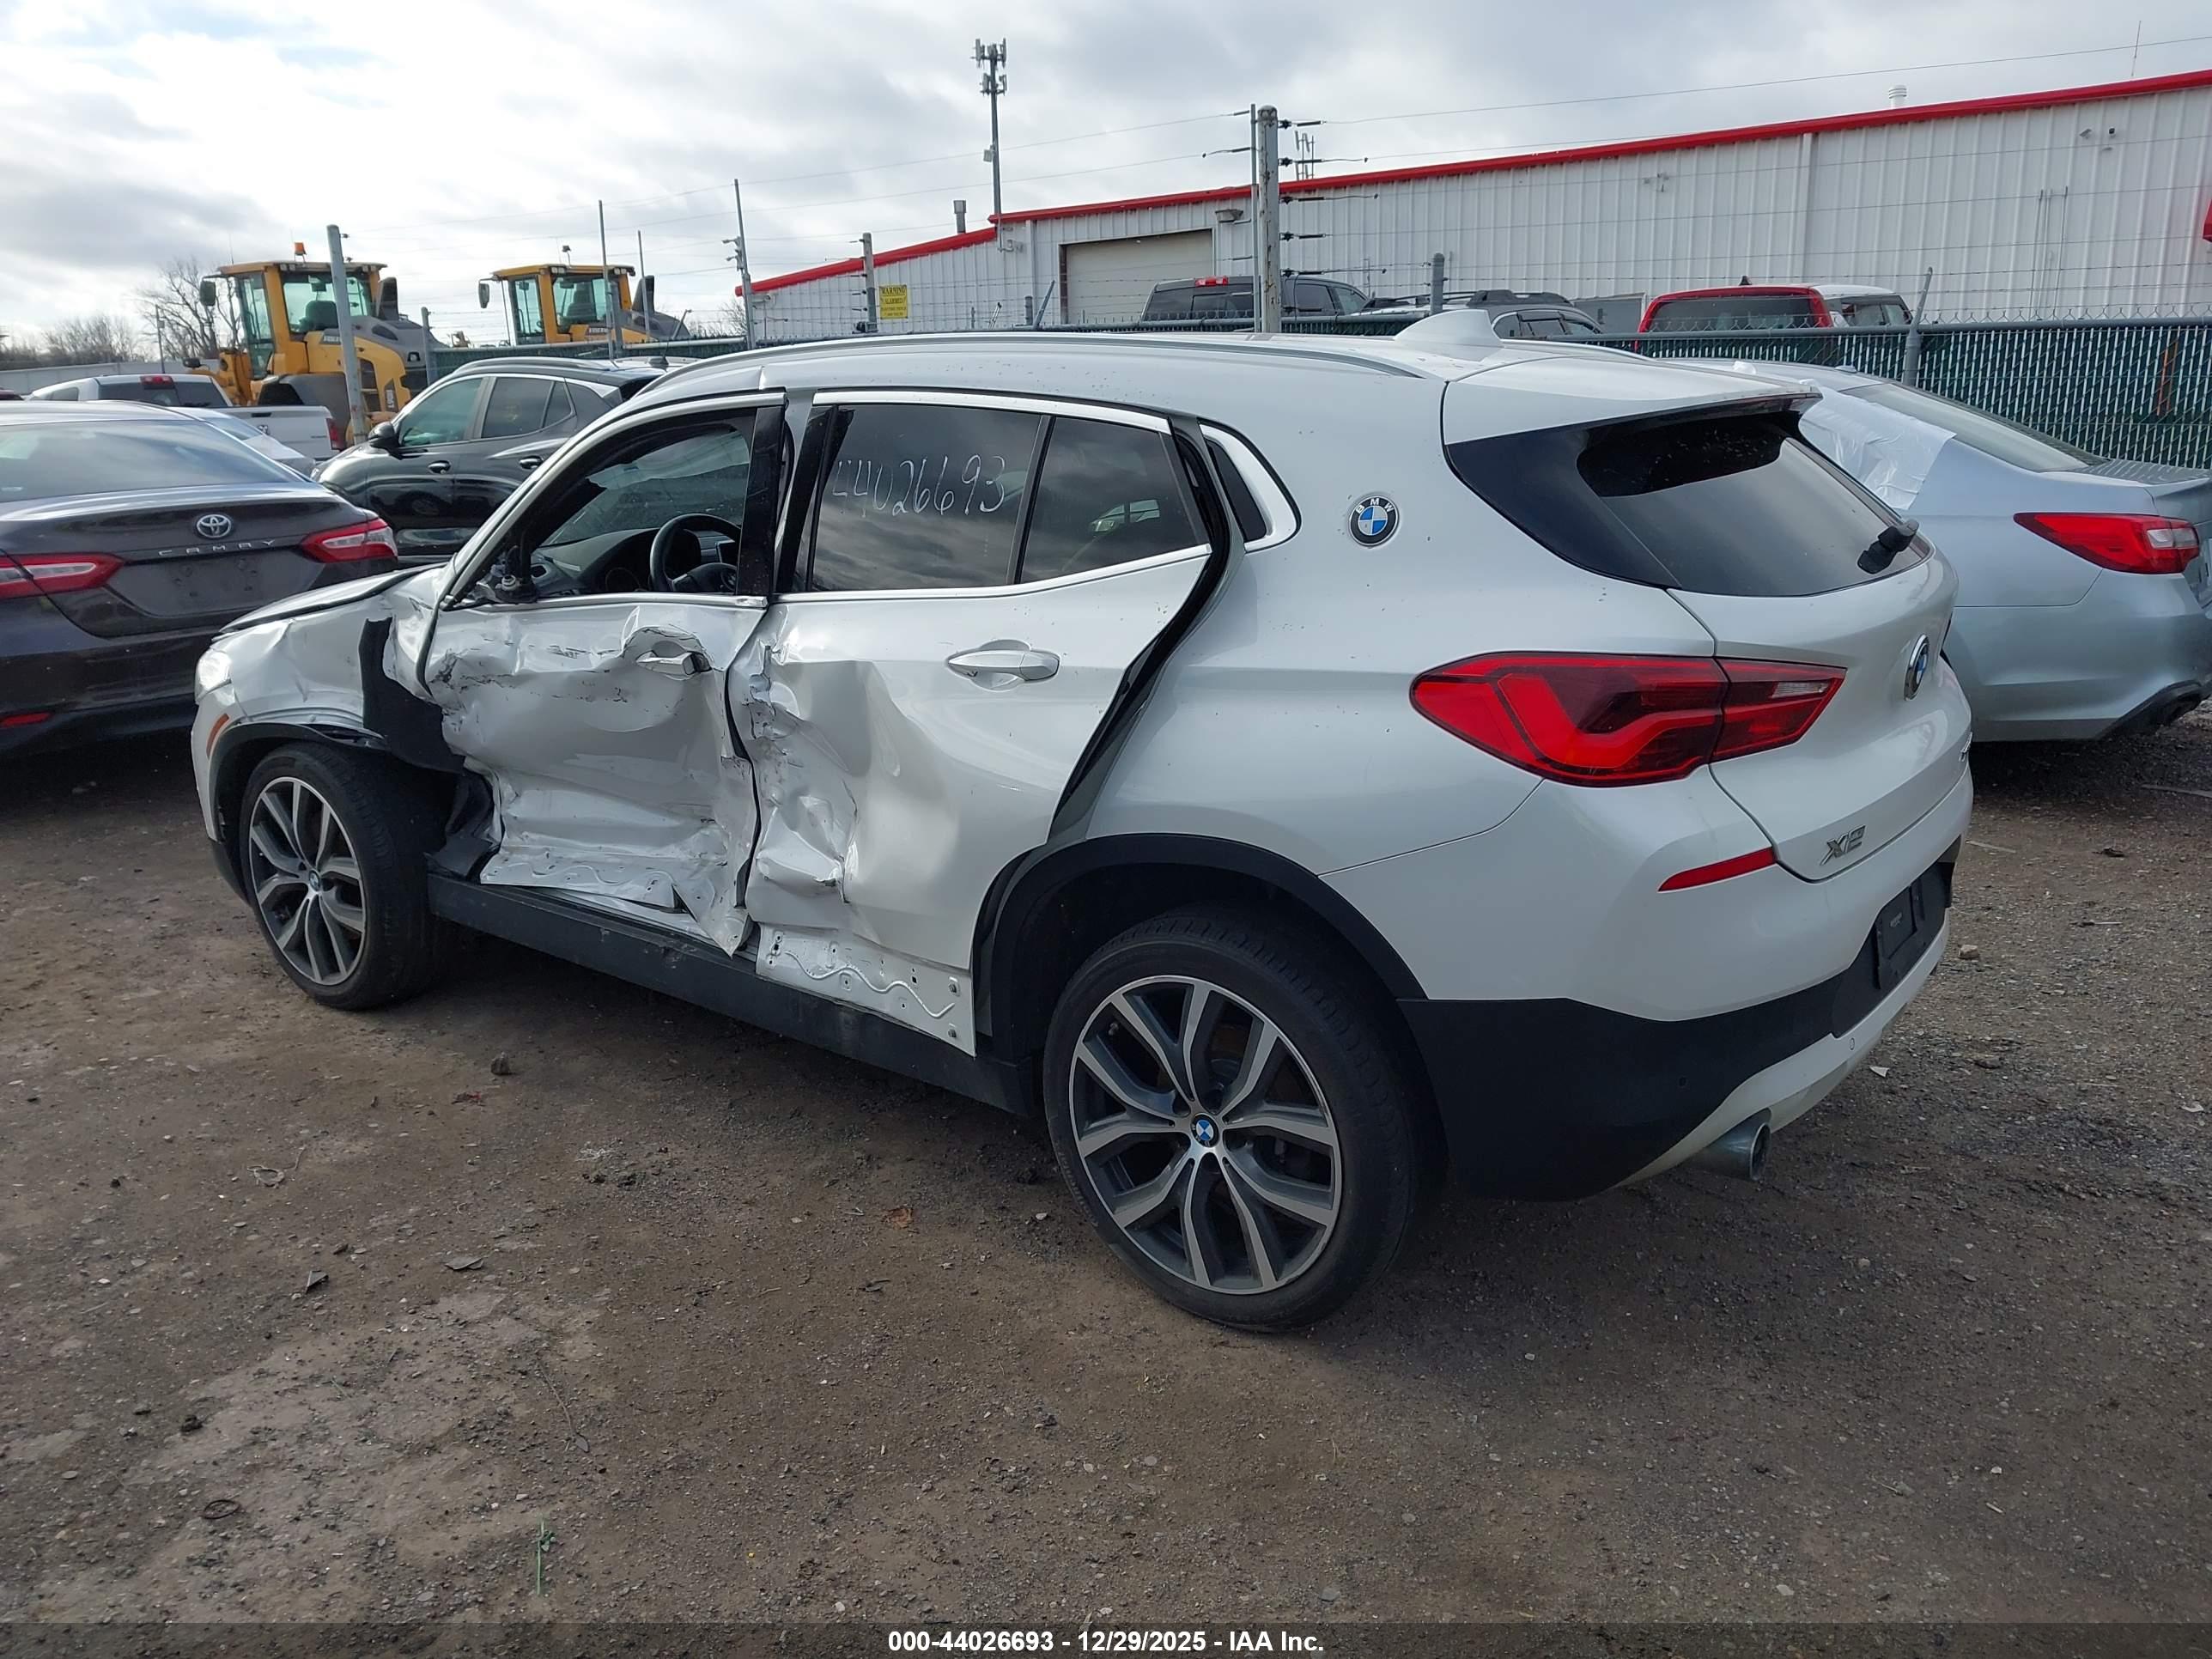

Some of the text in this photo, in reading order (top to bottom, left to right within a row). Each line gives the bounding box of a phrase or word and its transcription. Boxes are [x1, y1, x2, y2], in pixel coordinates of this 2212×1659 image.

[832, 453, 1006, 519] 44026693
[1355, 497, 1395, 514] BMW
[158, 538, 276, 557] CAMRY
[1820, 823, 1867, 866] X2
